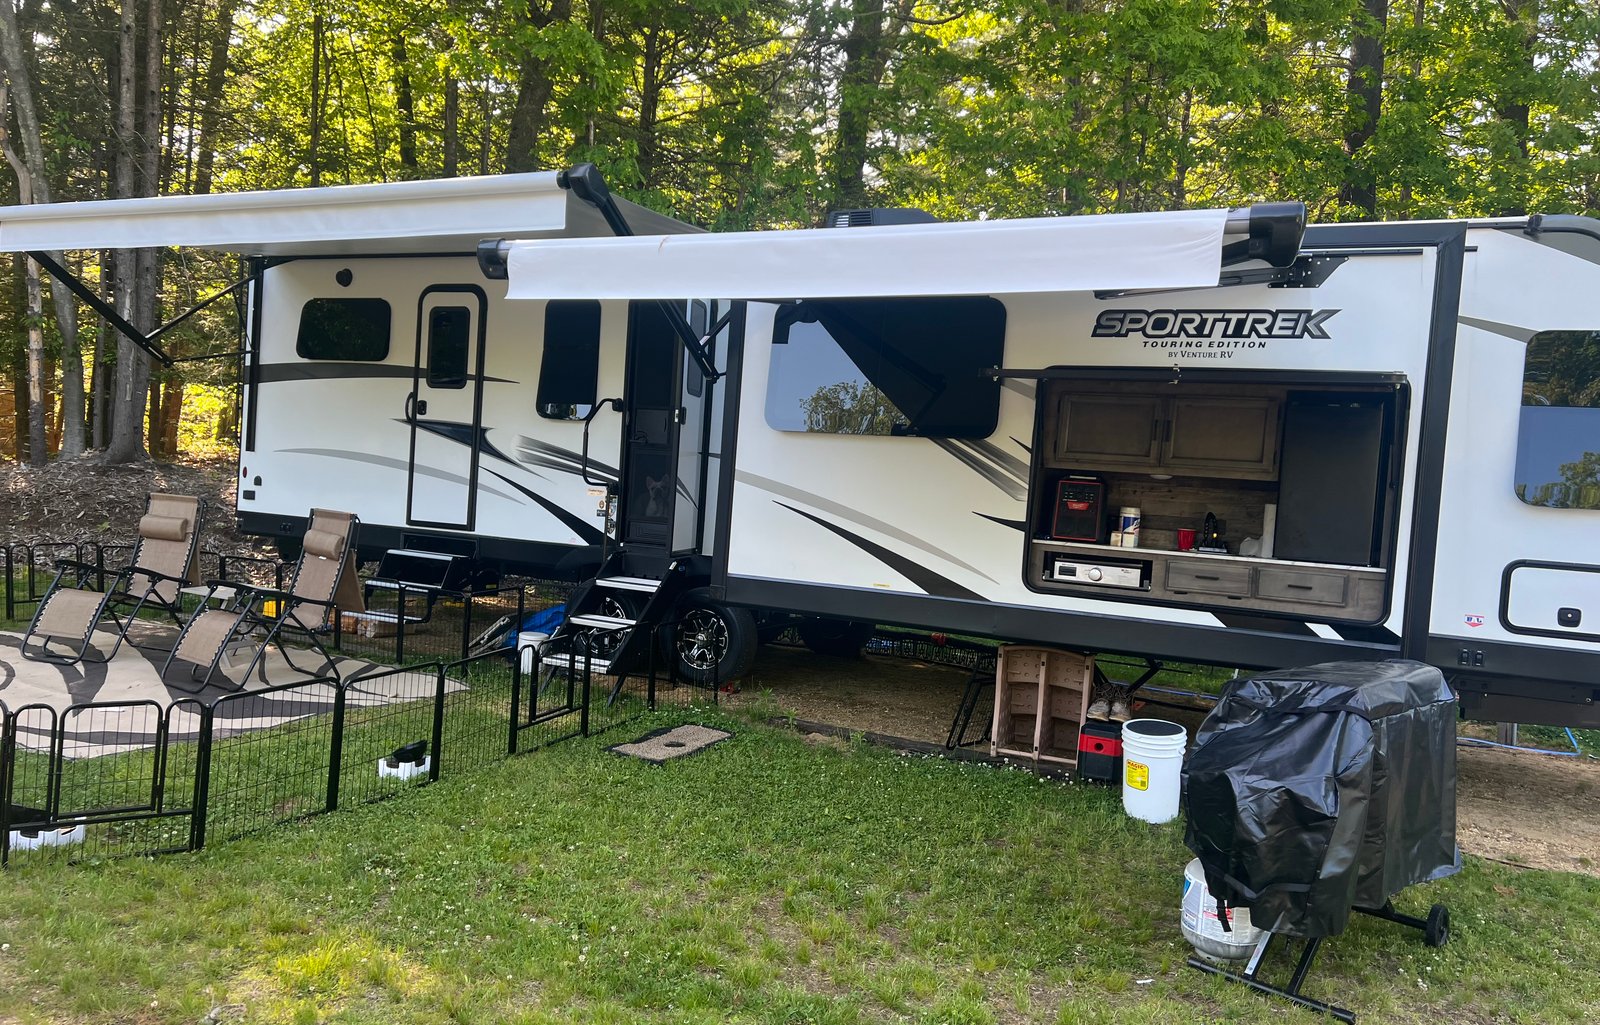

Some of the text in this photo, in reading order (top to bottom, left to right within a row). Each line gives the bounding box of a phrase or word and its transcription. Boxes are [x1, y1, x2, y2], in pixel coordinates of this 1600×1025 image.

[1091, 309, 1343, 339] SPORTTREK
[1208, 341, 1267, 349] EDITION
[1220, 351, 1234, 359] RV
